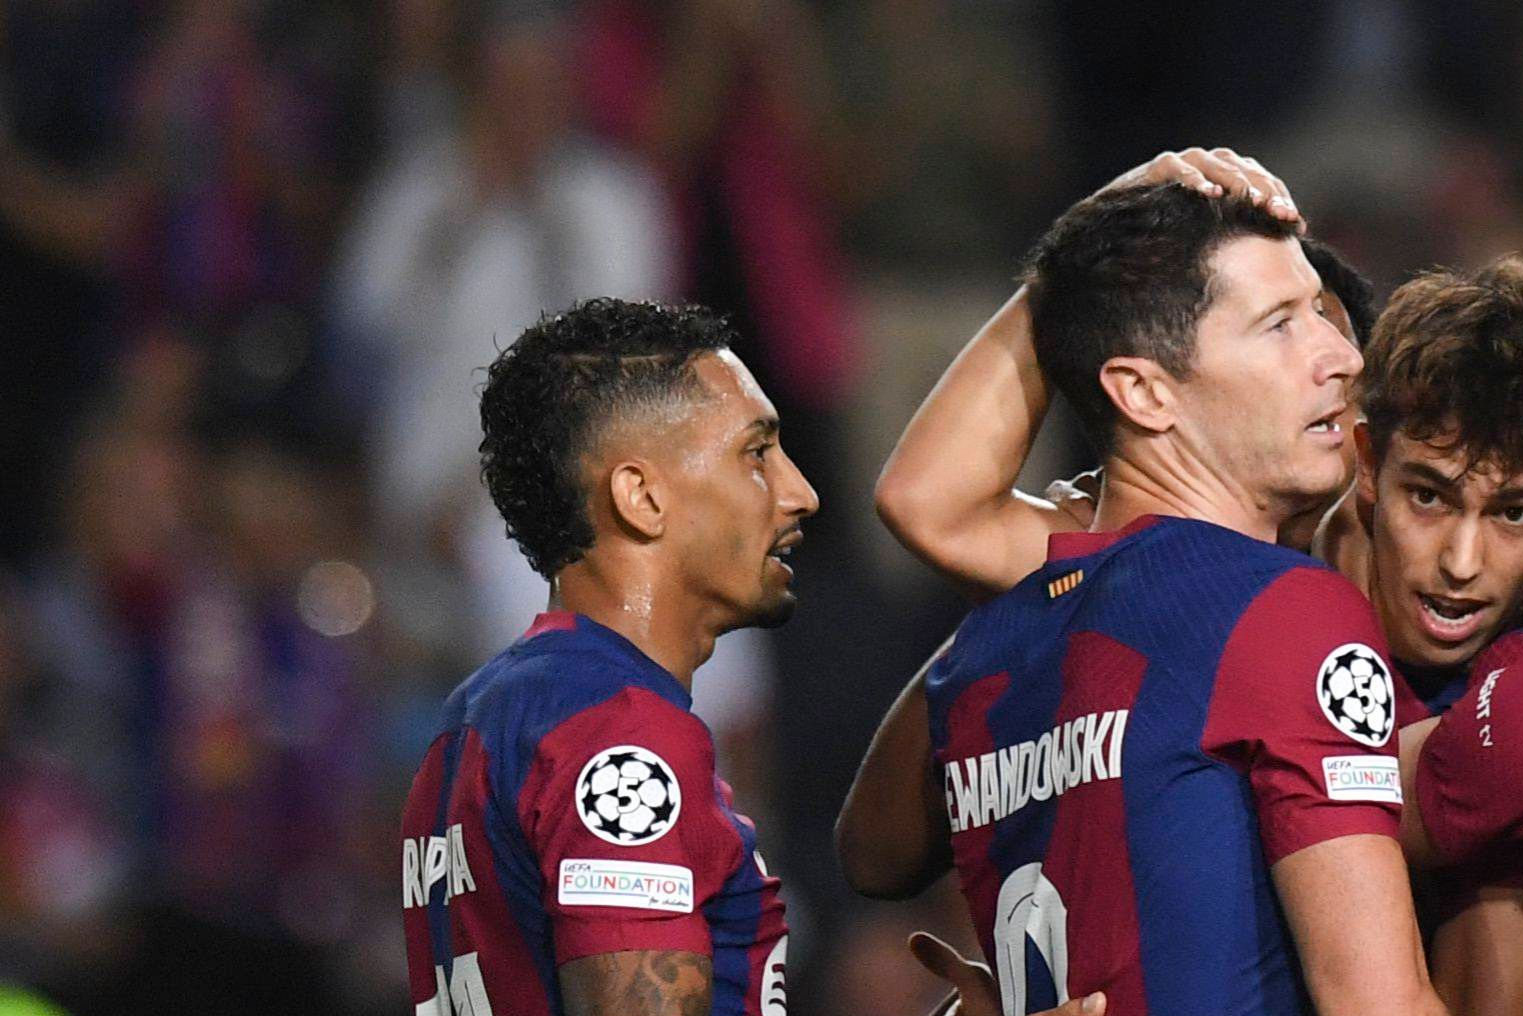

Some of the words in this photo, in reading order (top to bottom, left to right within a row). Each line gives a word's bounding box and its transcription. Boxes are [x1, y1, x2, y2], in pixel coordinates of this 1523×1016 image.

[1353, 675, 1376, 714] 5
[616, 776, 641, 814] 5
[563, 874, 690, 897] FOUNDATION
